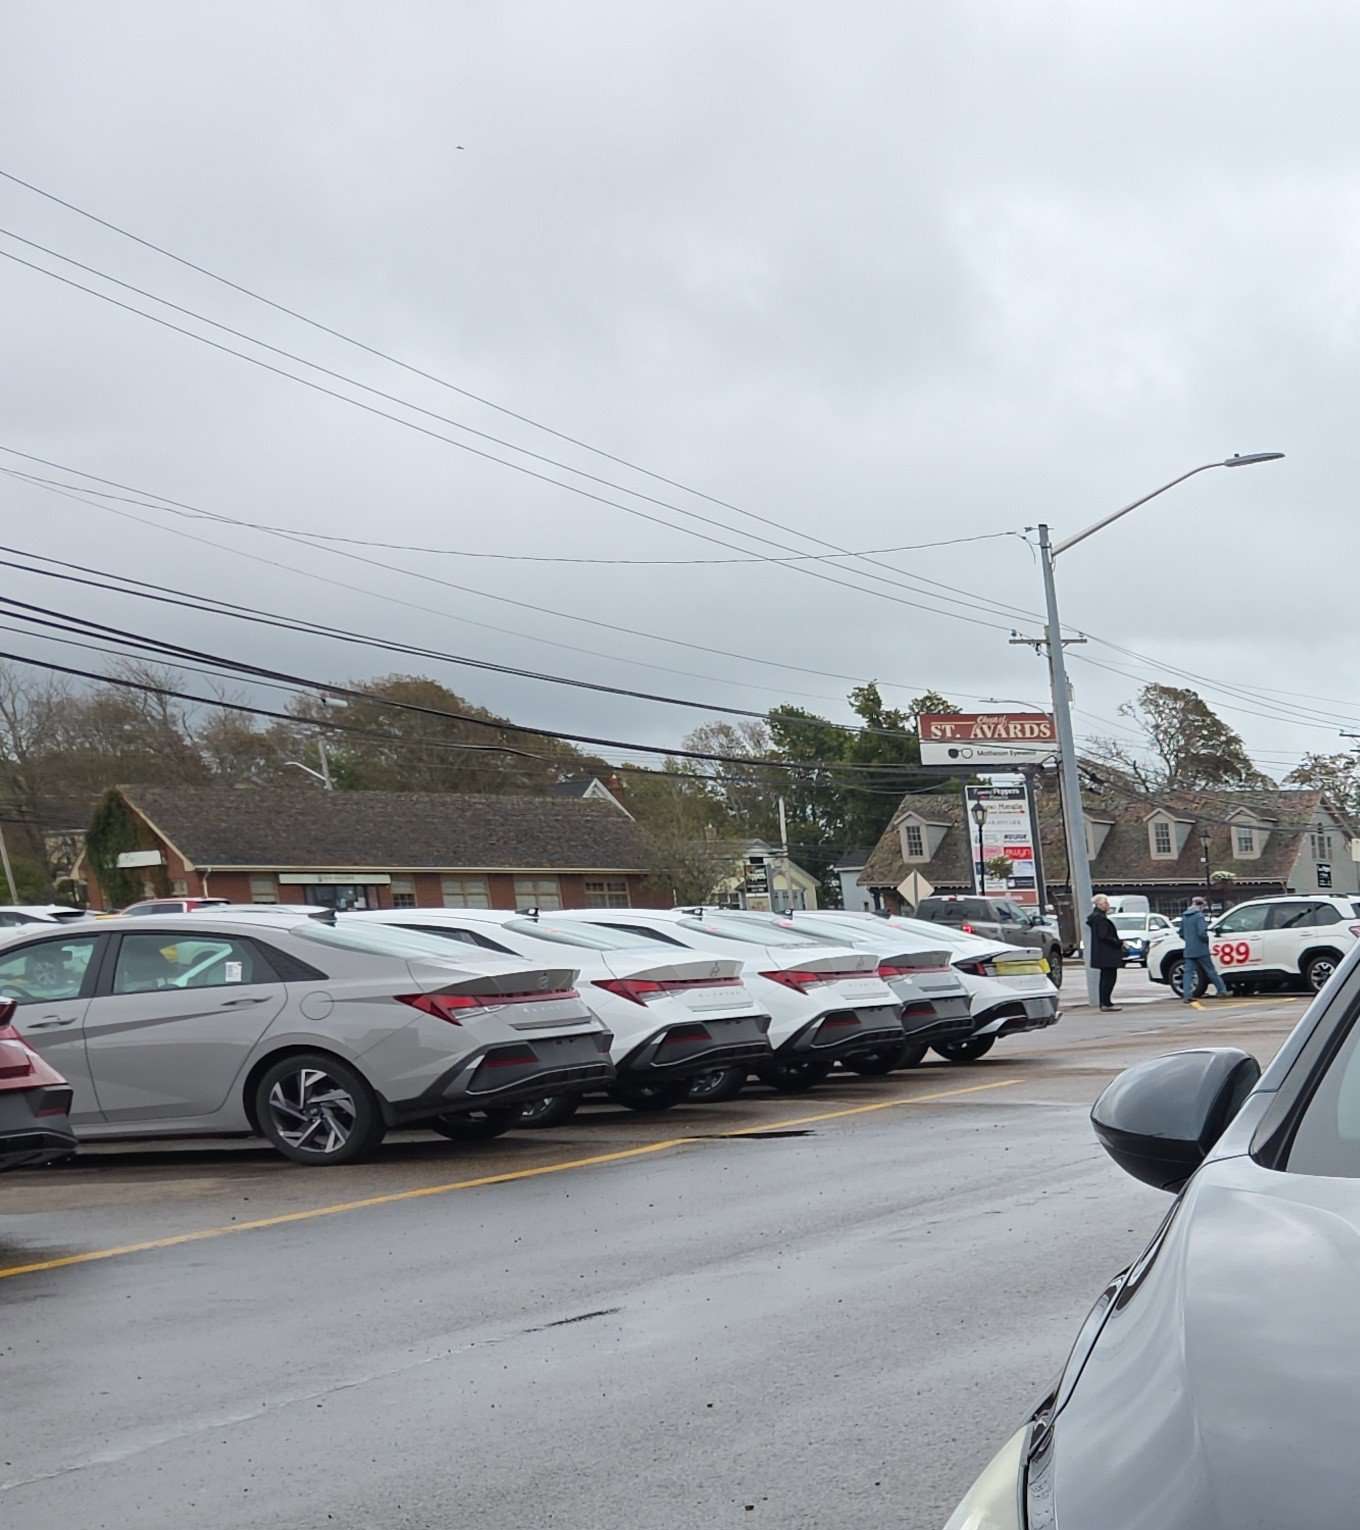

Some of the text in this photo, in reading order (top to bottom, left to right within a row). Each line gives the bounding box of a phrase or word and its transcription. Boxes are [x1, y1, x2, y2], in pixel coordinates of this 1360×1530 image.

[930, 723, 1051, 739] ST. AVARDS
[1211, 941, 1250, 966] $89
